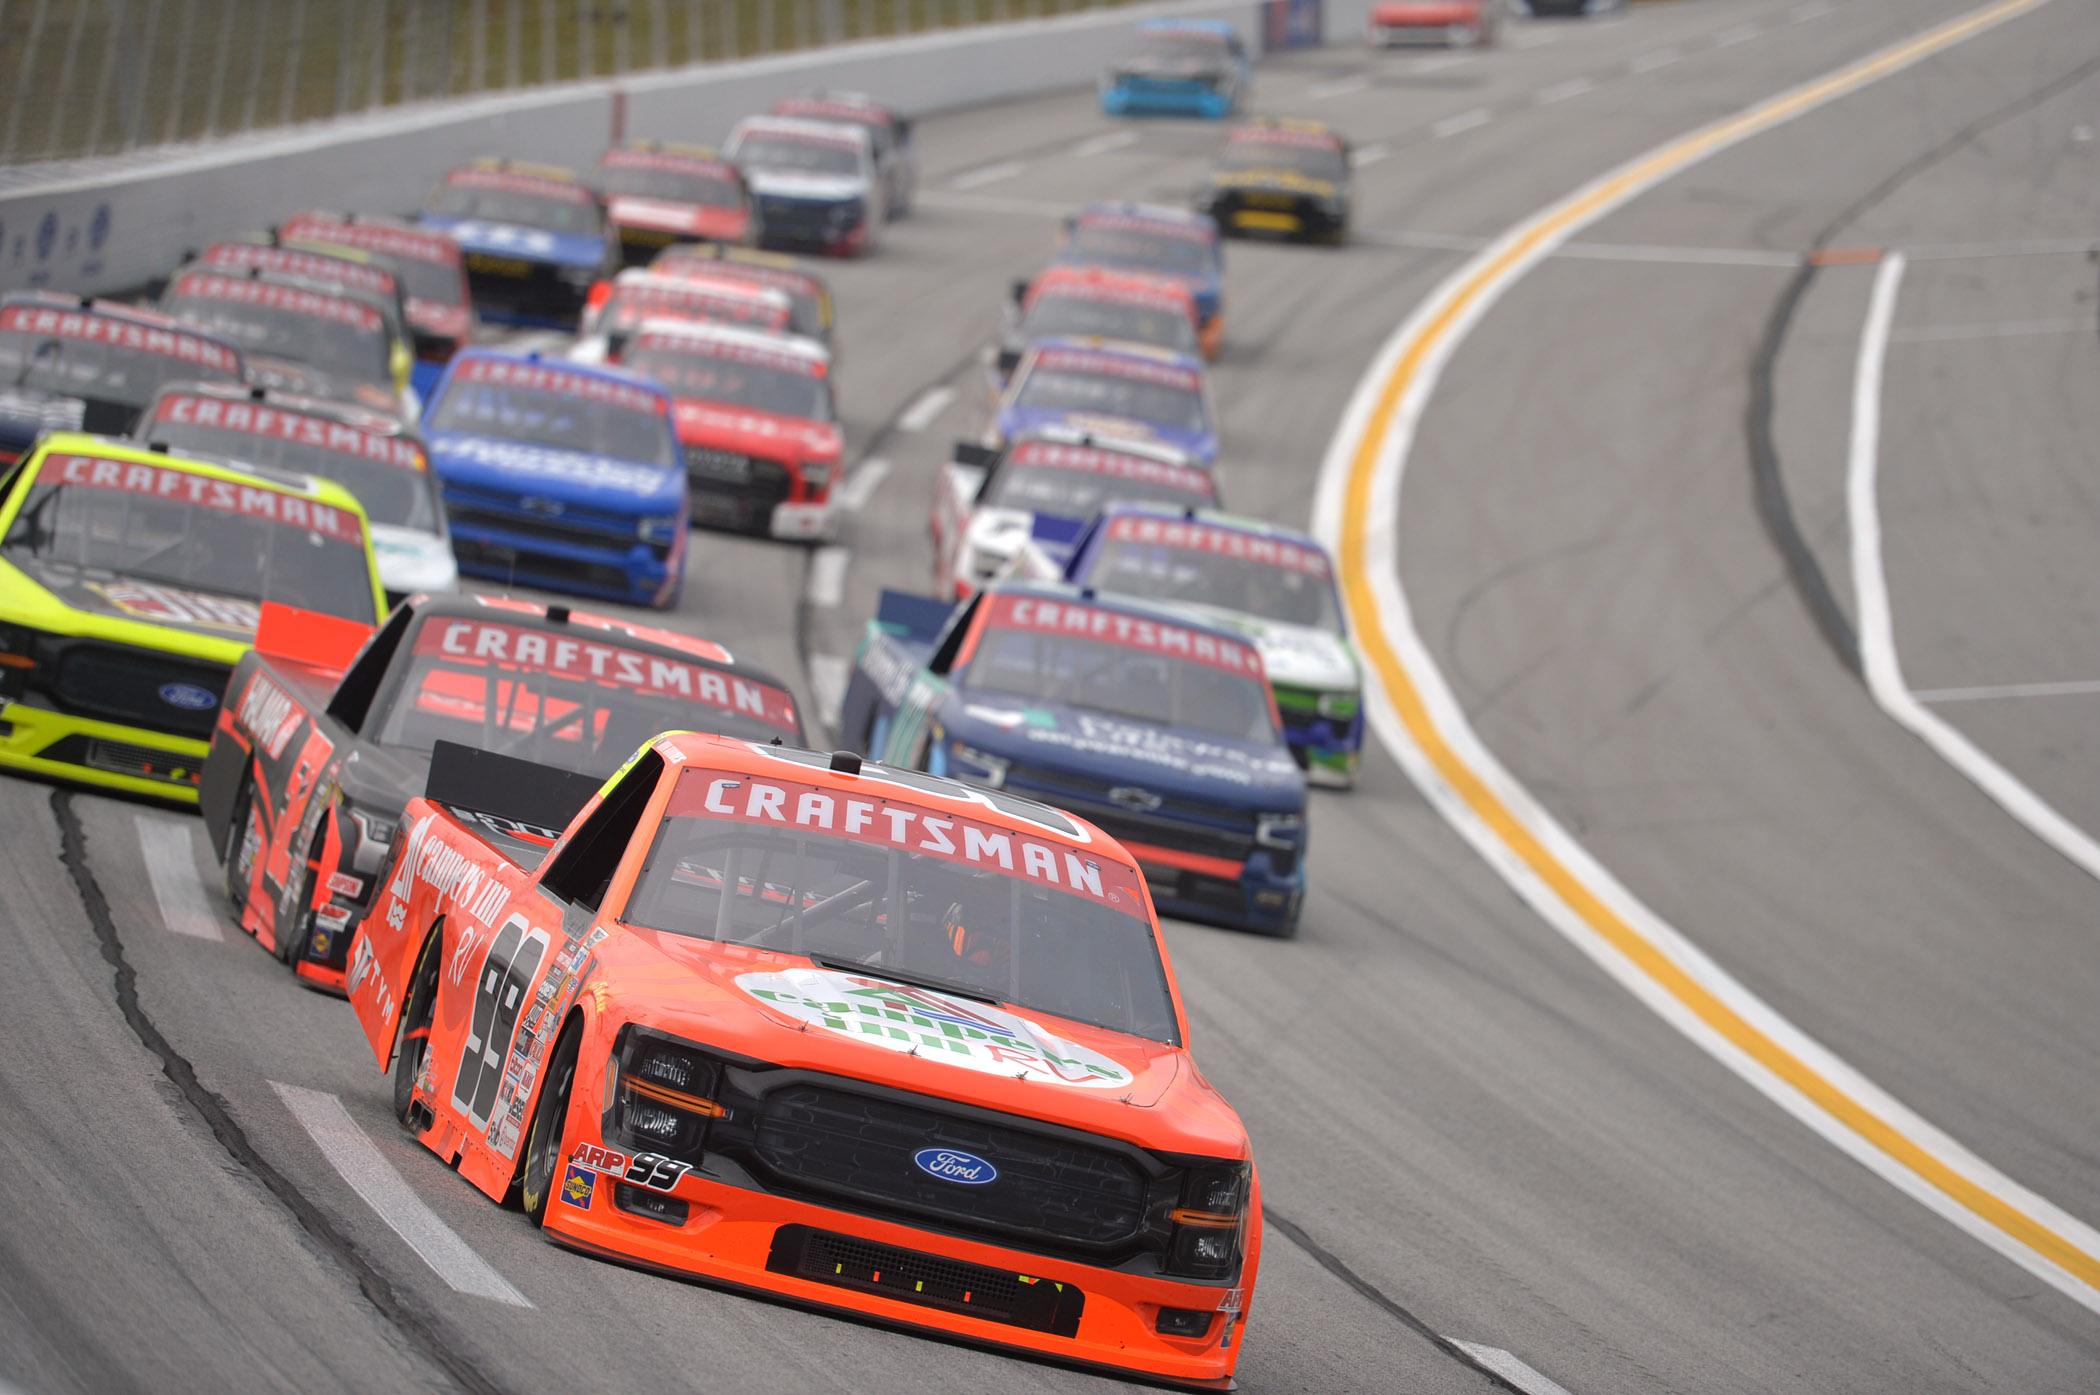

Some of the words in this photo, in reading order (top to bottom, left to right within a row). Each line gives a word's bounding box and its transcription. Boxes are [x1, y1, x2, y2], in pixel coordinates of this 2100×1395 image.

[170, 398, 416, 468] CRAFTSMAN
[64, 457, 338, 531] CRAFTSMAN
[1011, 600, 1244, 666] CRAFTSMAN
[442, 623, 764, 715] CRAFTSMAN
[704, 779, 1104, 898] CRAFTSMAN
[750, 989, 1124, 1081] campers
[984, 1044, 1109, 1083] RV
[564, 1179, 592, 1197] SUNOCO
[573, 1143, 625, 1170] ARP
[624, 1152, 693, 1192] 99
[929, 1152, 982, 1180] Ford
